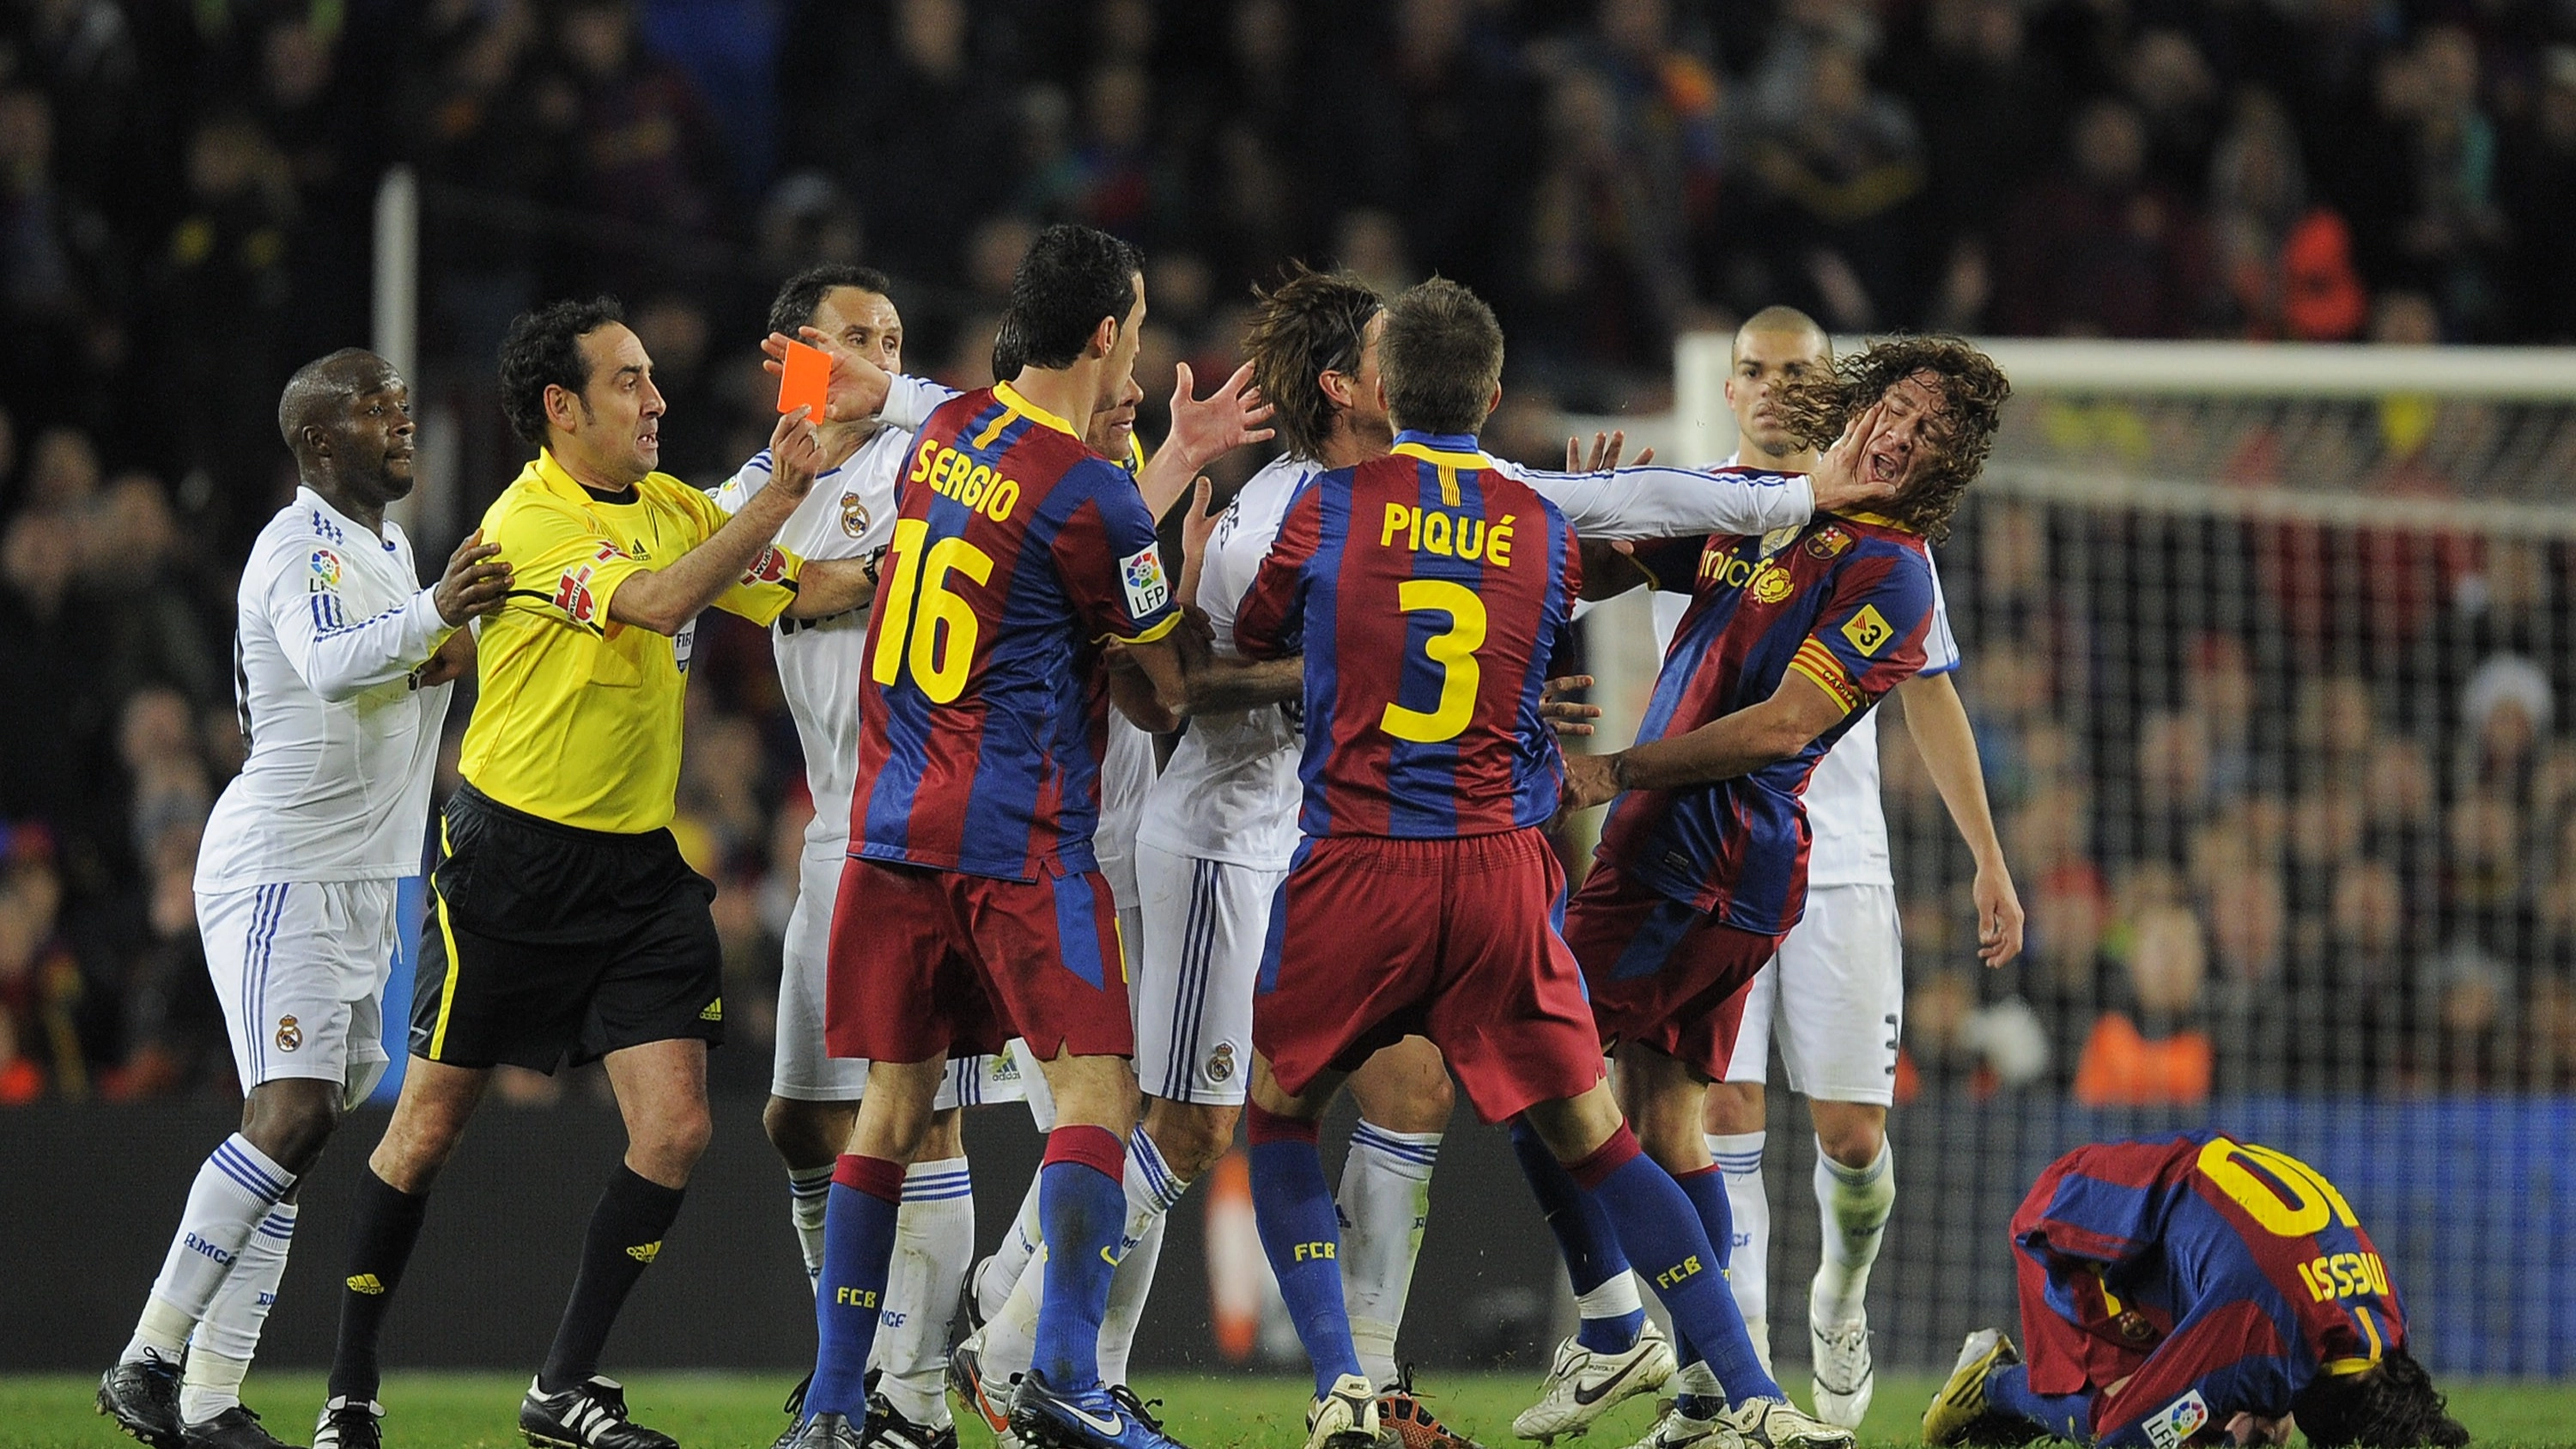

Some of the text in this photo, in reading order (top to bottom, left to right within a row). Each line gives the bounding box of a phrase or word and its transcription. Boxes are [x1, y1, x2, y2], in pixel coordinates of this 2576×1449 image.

[910, 439, 1020, 522] SERGIO
[1380, 502, 1516, 567] PIQUÉ
[872, 519, 994, 704] 16
[1134, 586, 1165, 614] LFP
[1860, 624, 1881, 647] 3
[1379, 580, 1487, 743] 3
[2196, 1136, 2360, 1237] 10
[1294, 1242, 1335, 1262] FCB
[1656, 1255, 1702, 1289] FCB
[2297, 1252, 2389, 1302] MESSI
[837, 1287, 876, 1308] FCB
